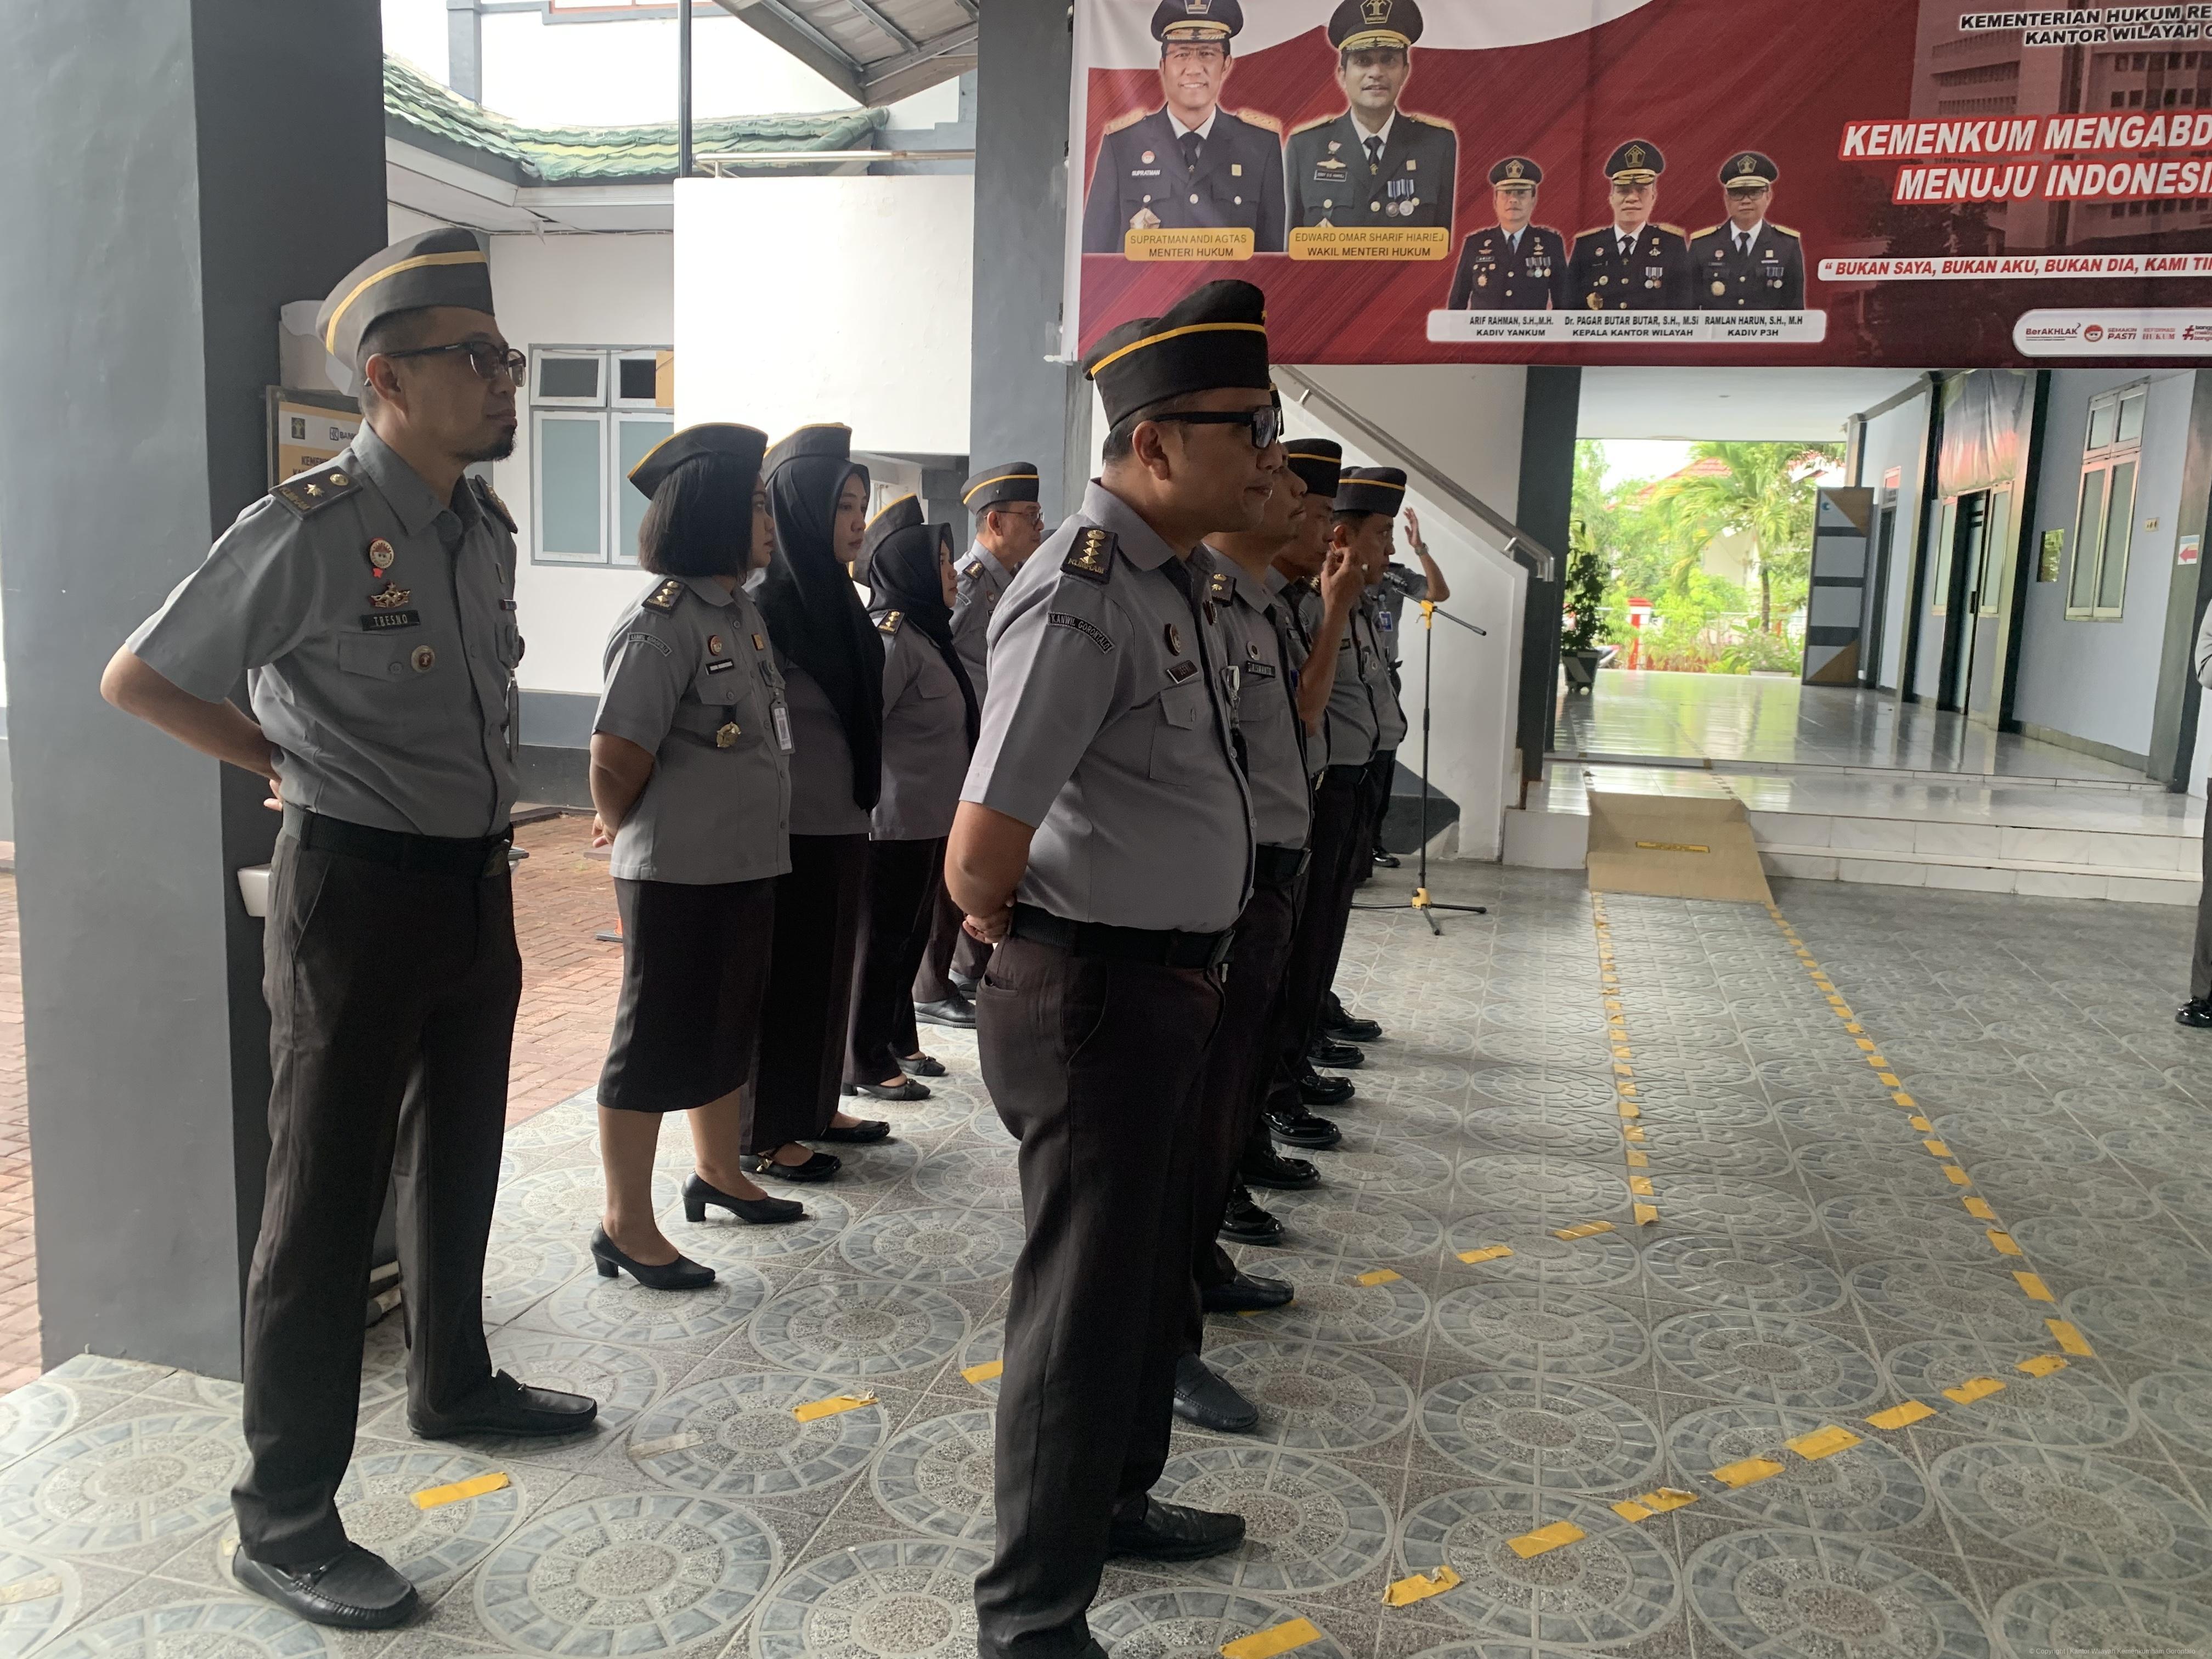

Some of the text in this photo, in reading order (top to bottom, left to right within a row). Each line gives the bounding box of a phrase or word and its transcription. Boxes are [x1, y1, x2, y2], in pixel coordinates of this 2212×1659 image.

[1961, 5, 2211, 29] KEMENTERIAN HUKUM RE
[2025, 29, 2106, 44] KANTOR
[2113, 25, 2199, 40] WILAYAH
[1843, 114, 2212, 156] KEMENKUM MENGABD
[1897, 162, 2212, 200] MENUJU INDONESI
[1131, 234, 1246, 244] SUPRATMAN ANDI AGTAS
[1295, 233, 1444, 241] EDWARD OMAR SHARIF HIARIEJ
[1149, 248, 1233, 257] MENTERI HUKUM
[1307, 247, 1431, 256] WAKIL MENTERI HUKUM
[1836, 262, 1889, 274] BUKAN
[1894, 261, 1936, 276] SAYA,
[1942, 260, 1998, 274] BUKAN
[2000, 260, 2039, 275] AKU,
[2045, 258, 2102, 272] BUKAN
[2107, 258, 2138, 274] DIA,
[2145, 257, 2188, 271] KAMI
[1470, 317, 1486, 325] ARIF
[1488, 317, 1520, 326] RAHMAN,
[1565, 316, 1699, 326] Dr. PAGAR BUTAR BUTAR, S.H., M.Si
[1705, 316, 1803, 326] RAMLAN HARUN, S.H., M.H
[1051, 614, 1110, 650] KANWIL GORONTALO
